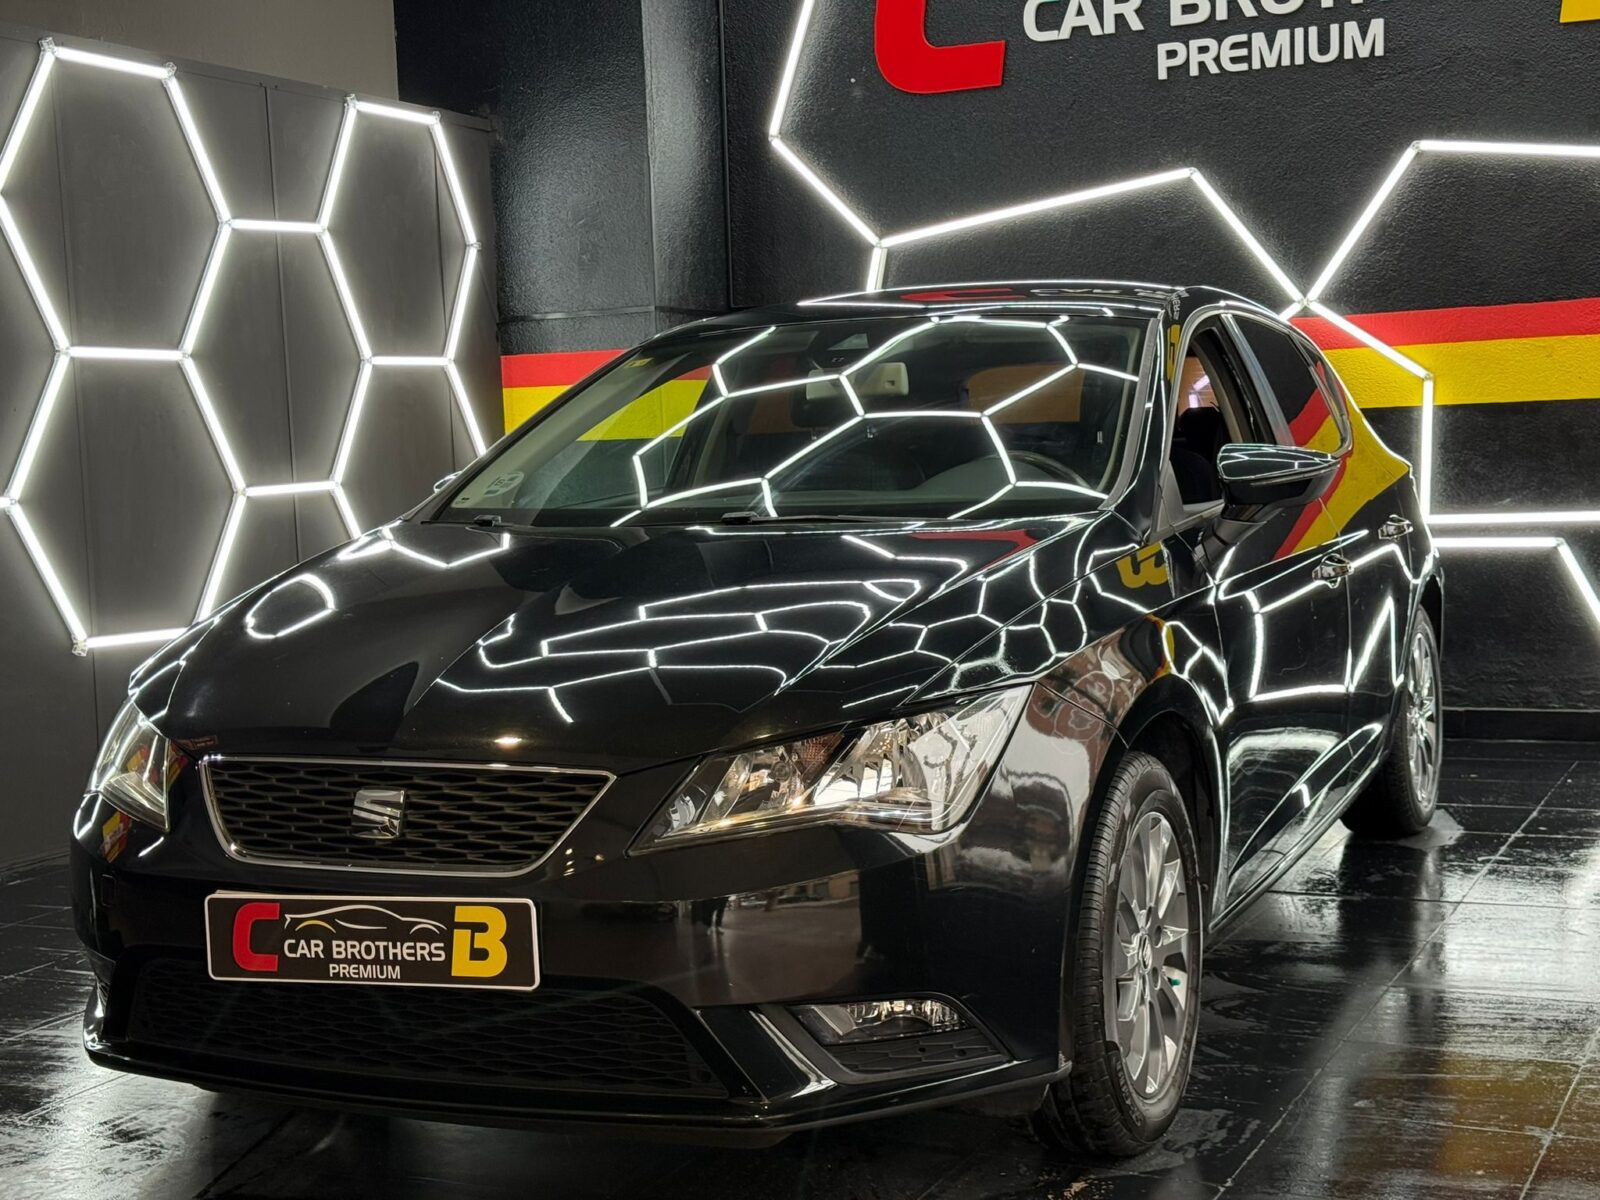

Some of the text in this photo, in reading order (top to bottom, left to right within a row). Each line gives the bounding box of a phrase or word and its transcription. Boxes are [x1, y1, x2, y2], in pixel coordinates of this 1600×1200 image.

[1157, 18, 1385, 80] PREMIUM
[284, 939, 446, 962] CAR BROTHERS
[329, 963, 401, 980] PREMIUM
